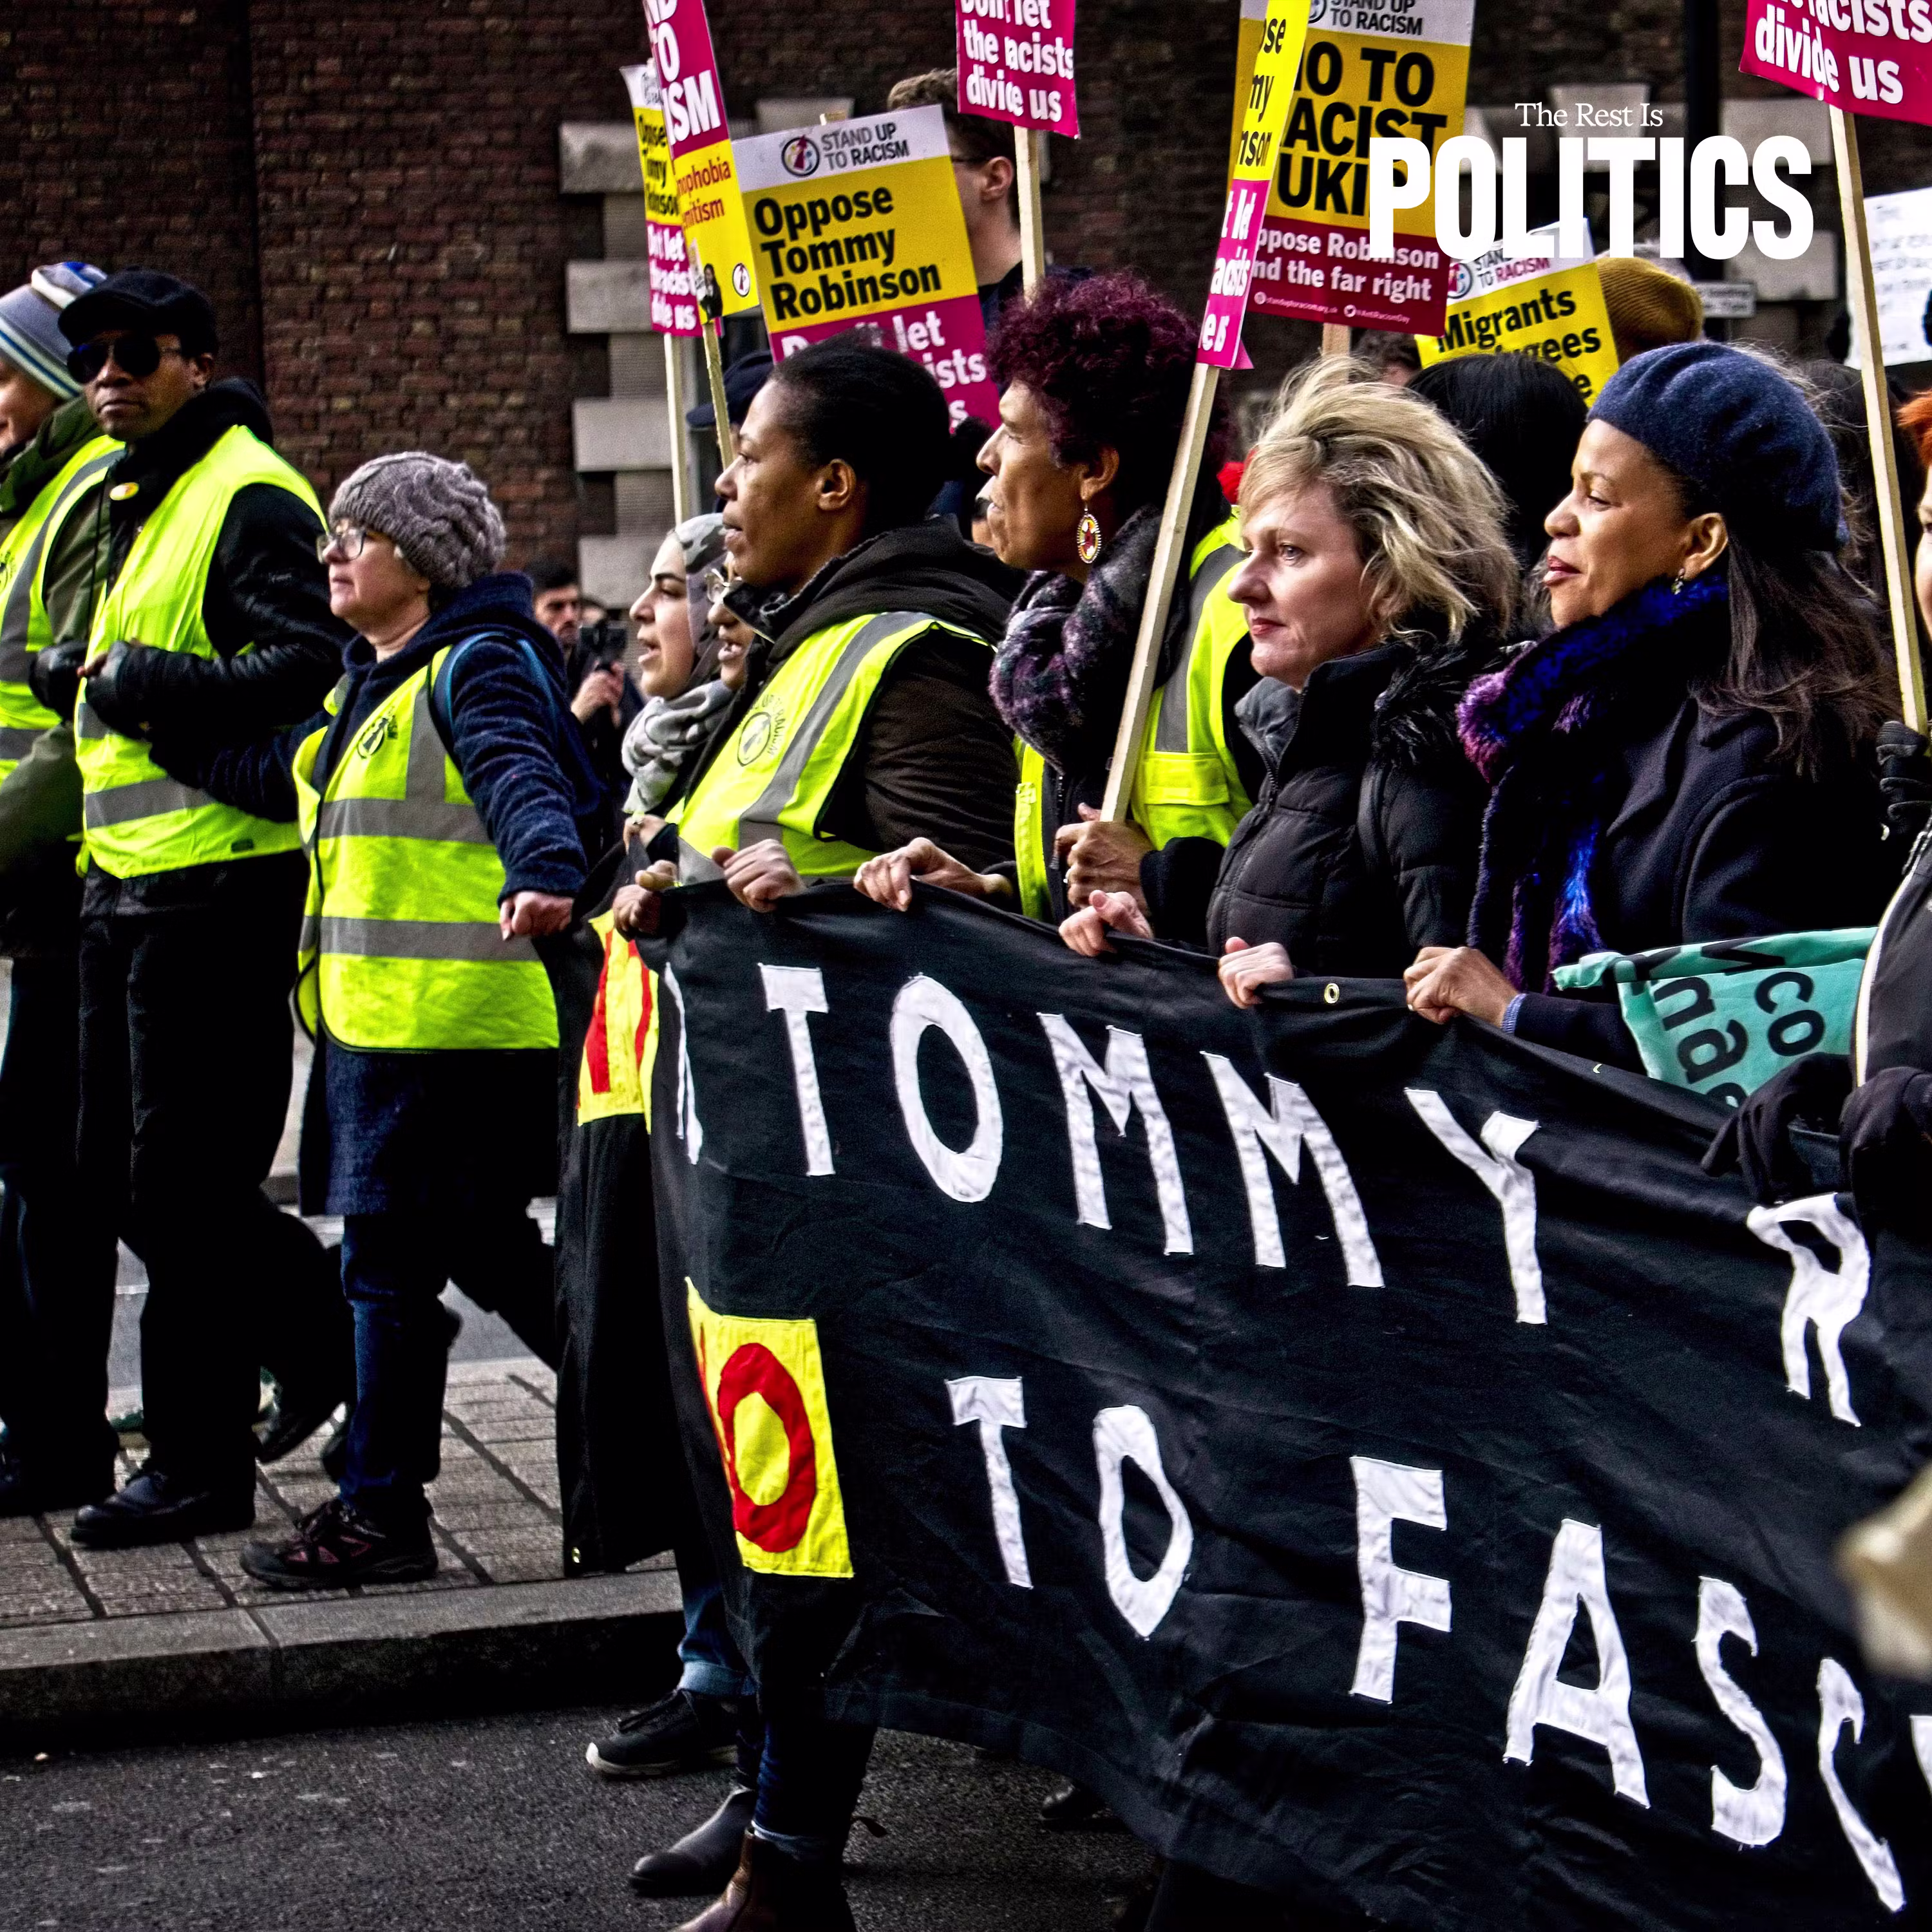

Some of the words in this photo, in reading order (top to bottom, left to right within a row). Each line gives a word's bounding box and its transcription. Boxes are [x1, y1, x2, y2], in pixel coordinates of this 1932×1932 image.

[963, 19, 999, 64] the
[1331, 8, 1351, 27] TO
[1356, 12, 1423, 35] RACISM
[1294, 41, 1343, 96] O
[1360, 47, 1435, 107] TO
[1755, 3, 1840, 93] divide
[1848, 55, 1904, 104] us
[1029, 89, 1062, 122] us
[821, 127, 872, 151] STAND
[875, 122, 896, 141] UP
[825, 152, 848, 170] TO
[851, 140, 910, 166] RACISM
[1280, 97, 1448, 166] ACIST
[754, 187, 894, 242] Oppose
[760, 228, 896, 278] Tommy
[1258, 228, 1321, 254] ppose
[770, 263, 942, 321] Robinson
[1253, 257, 1282, 281] nd
[1287, 260, 1325, 287] the
[1331, 265, 1367, 292] far
[1372, 272, 1432, 304] right
[892, 310, 945, 354] let
[1438, 289, 1577, 353] Migrants
[922, 348, 987, 388] ists
[758, 963, 1547, 1325] TOMMY
[717, 1343, 817, 1553] O
[945, 1376, 1193, 1640] TO
[1349, 1455, 1931, 1913] FASC
